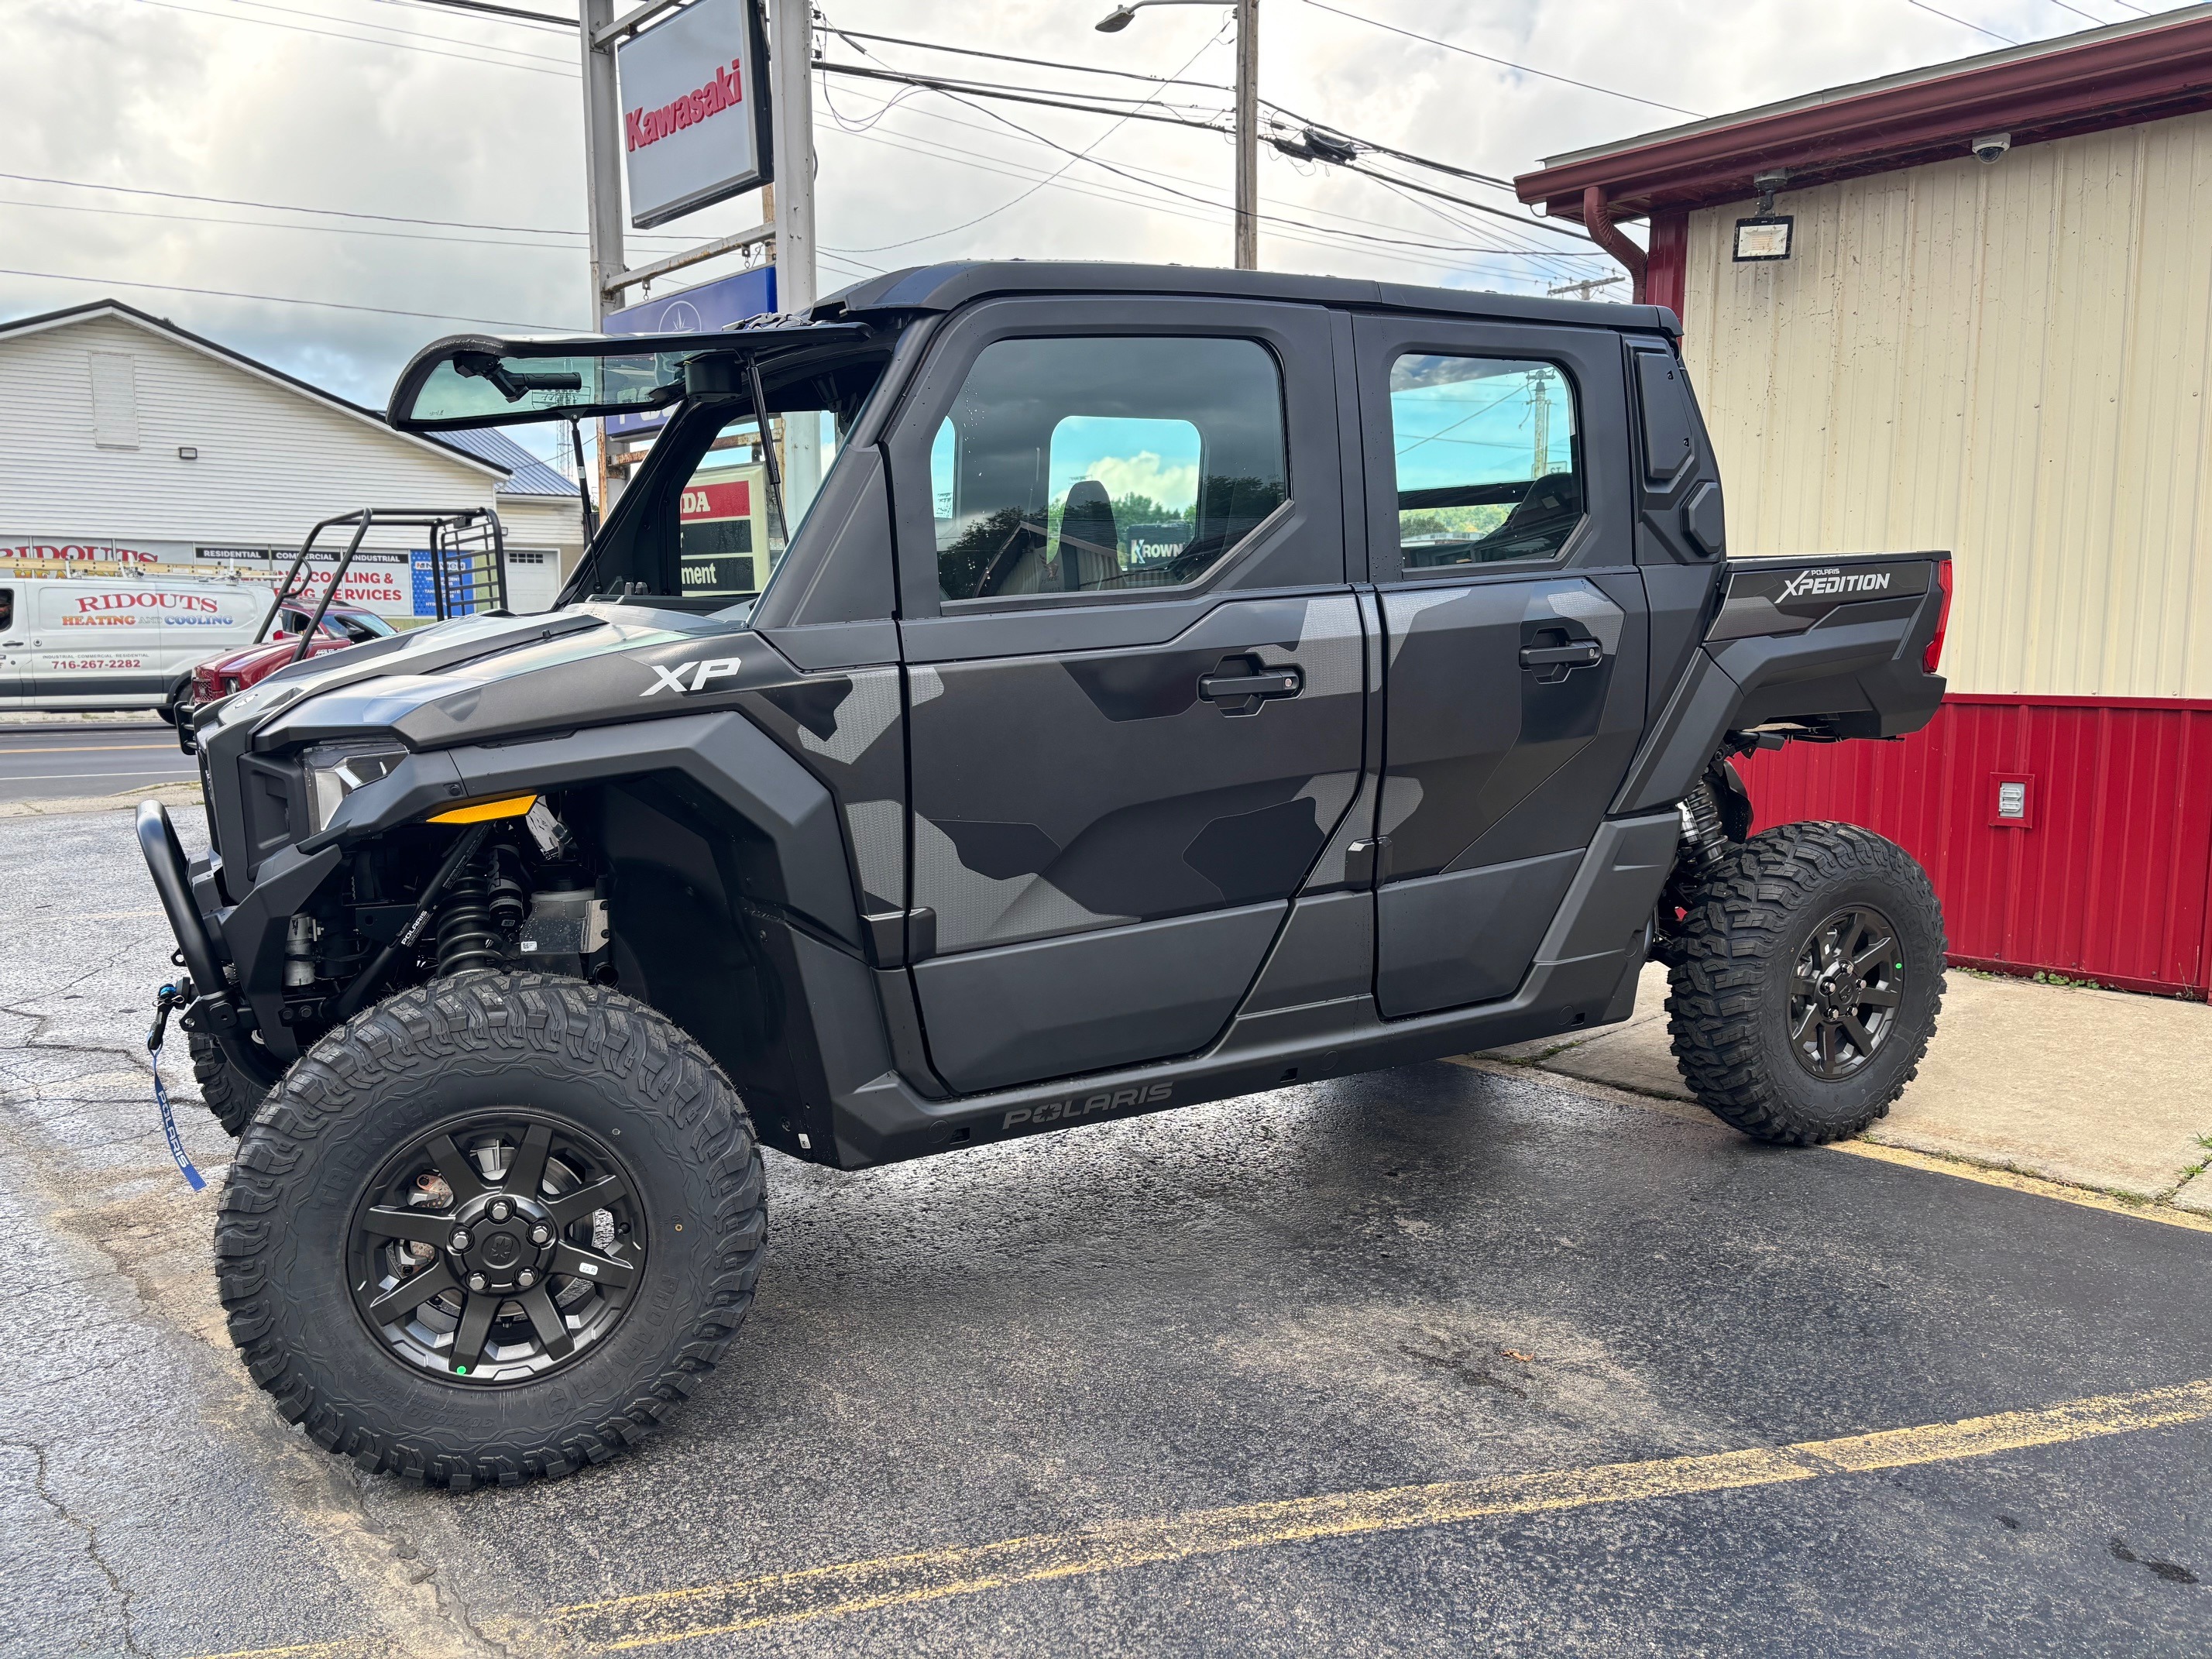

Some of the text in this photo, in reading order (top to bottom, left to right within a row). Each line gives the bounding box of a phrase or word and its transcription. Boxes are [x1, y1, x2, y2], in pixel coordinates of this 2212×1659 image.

[625, 58, 743, 153] Kawasaki
[680, 491, 711, 514] DA
[0, 544, 159, 563] IDOUTS
[204, 550, 262, 558] RESIDENTIAL
[276, 551, 334, 561] COMERCIAL
[1131, 539, 1184, 564] KROWN
[383, 572, 393, 584] &
[1774, 570, 1891, 604] XPEDITION
[75, 592, 218, 613] RIDOUTS
[323, 589, 402, 601] ERVICES
[62, 615, 234, 626] HEATING AND COOLING
[51, 659, 141, 669] 716-267-2282
[639, 657, 742, 697] XP
[400, 910, 428, 945] POLARIS
[1002, 1081, 1173, 1130] POLARIS
[157, 1090, 189, 1168] POLARIS
[311, 1090, 449, 1210] TREKKER
